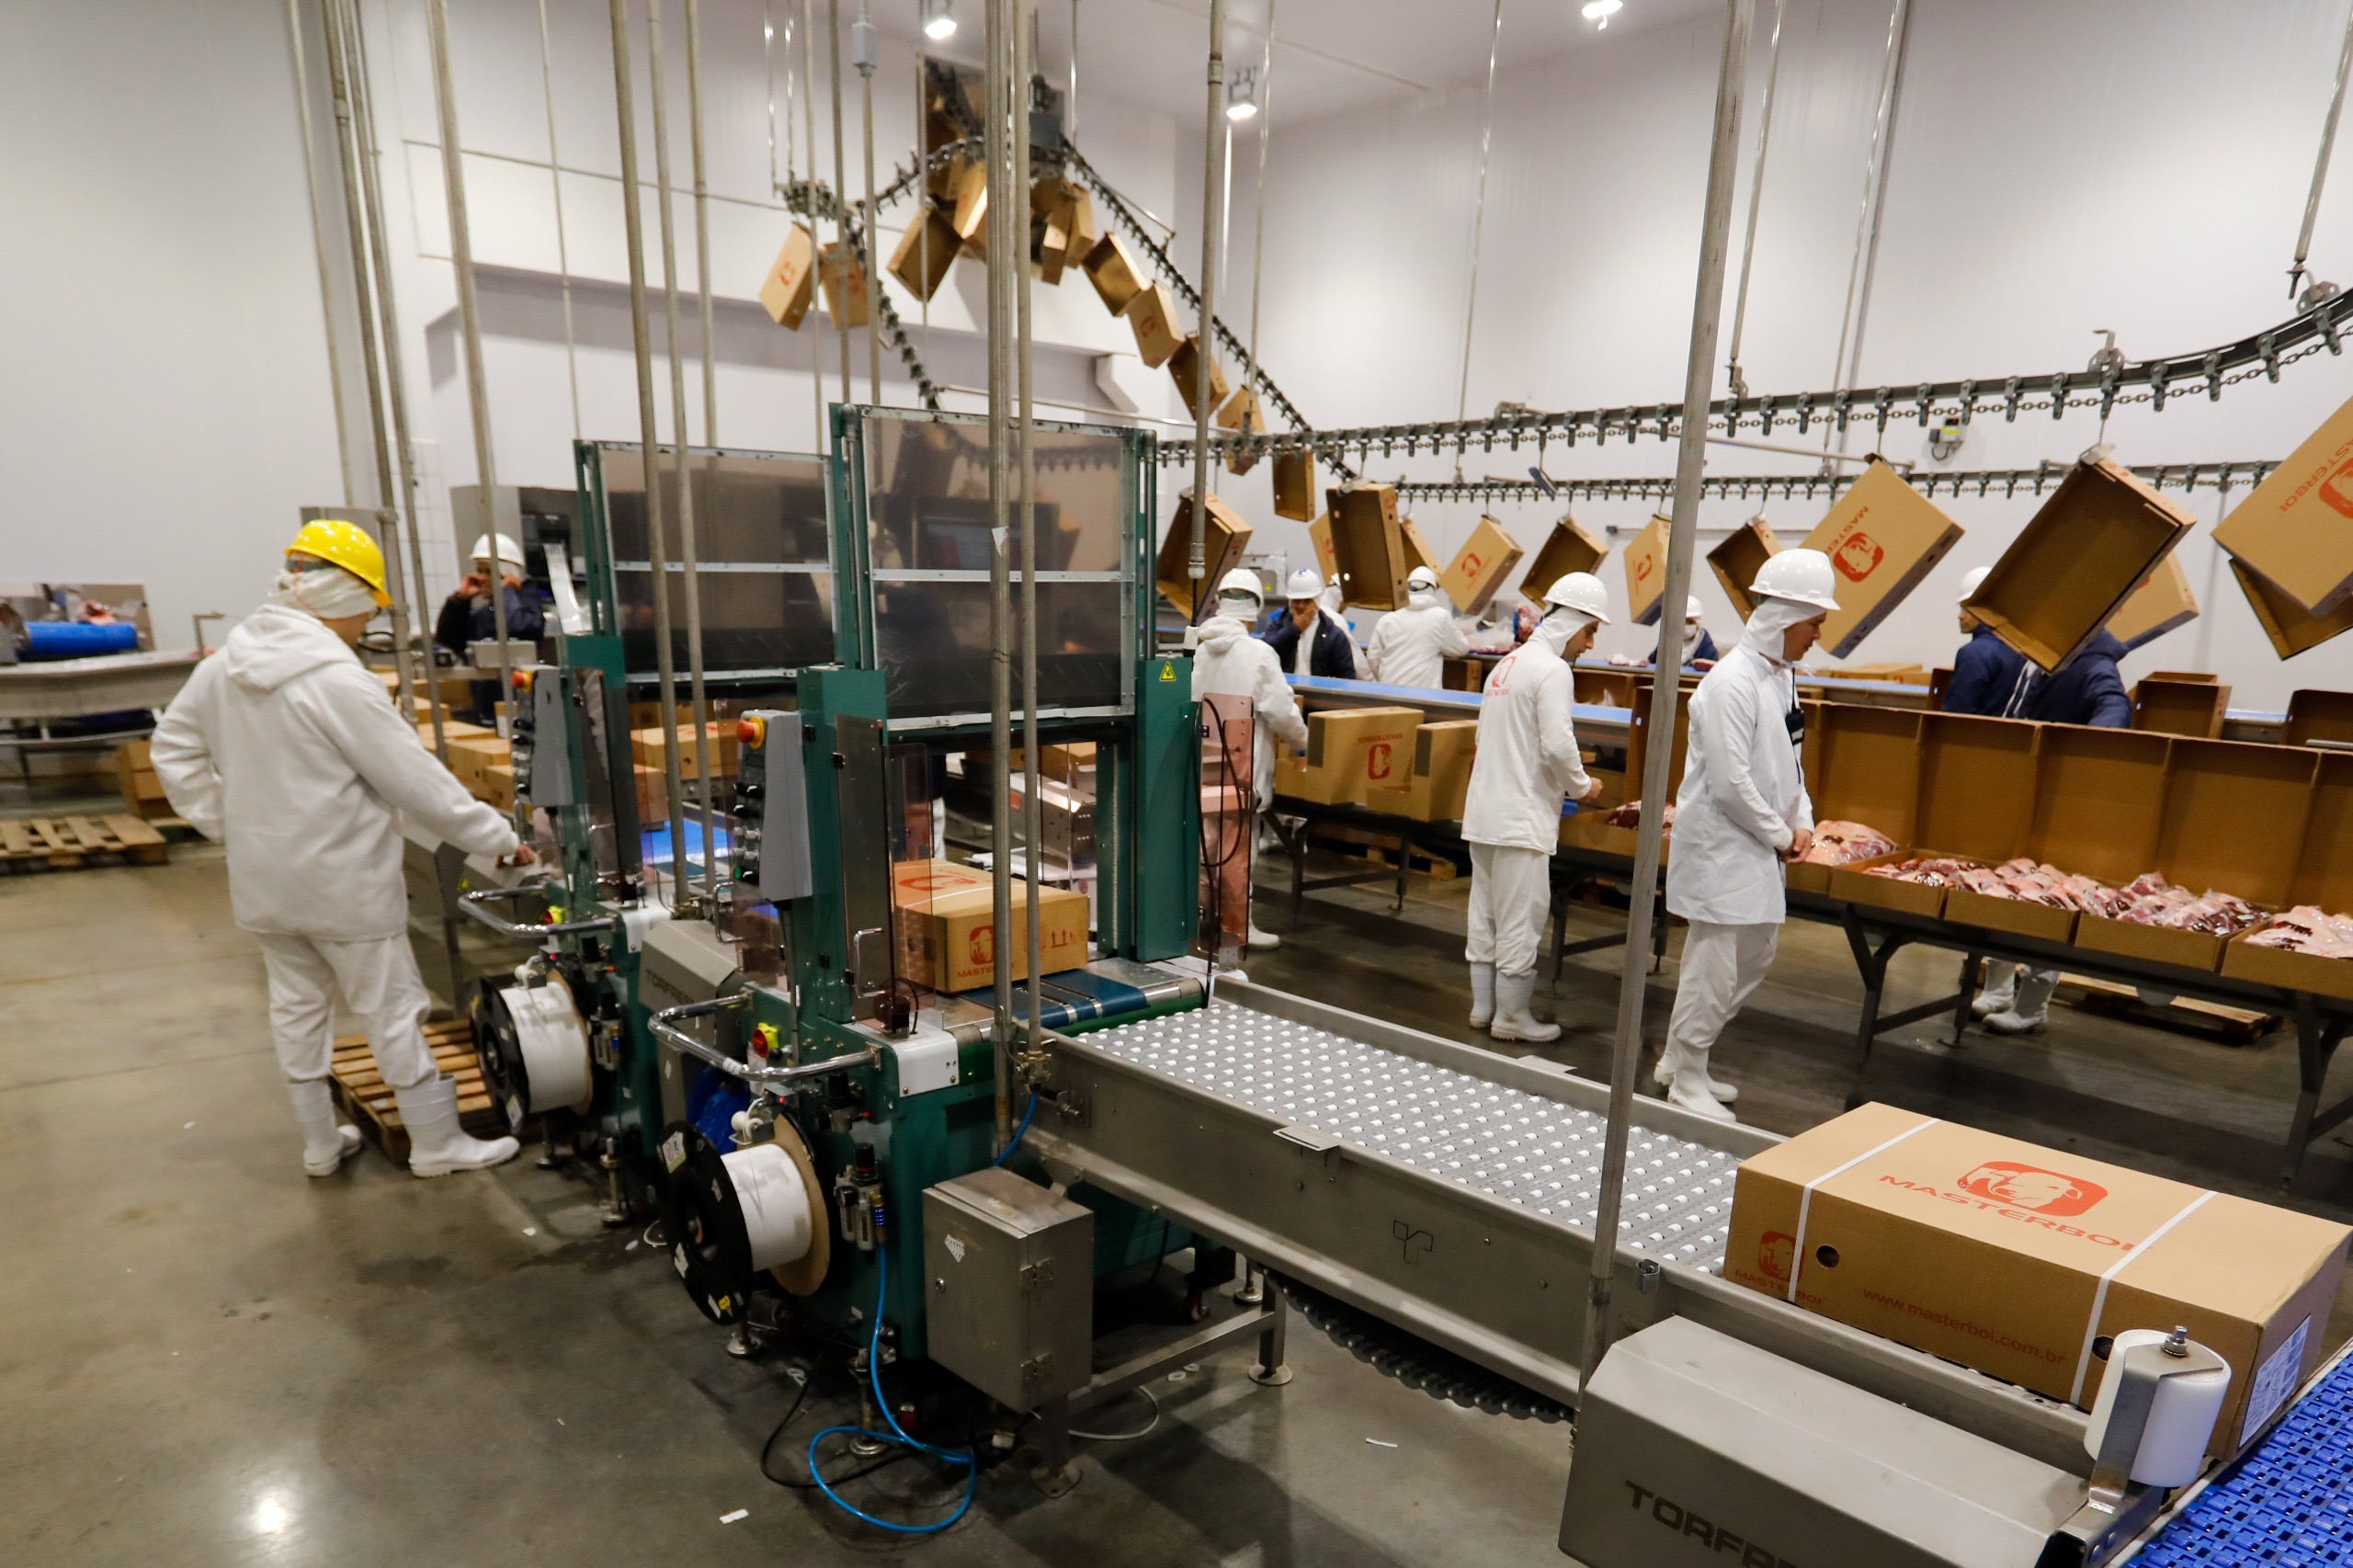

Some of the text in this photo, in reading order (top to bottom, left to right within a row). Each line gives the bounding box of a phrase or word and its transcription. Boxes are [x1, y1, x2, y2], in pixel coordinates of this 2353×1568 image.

[1878, 1175, 2135, 1252] MASTERBOI
[1734, 1269, 1823, 1304] MASTEBOI
[1862, 1288, 2066, 1366] www.masterboi.com.br
[1624, 1479, 1800, 1568] TORFR
